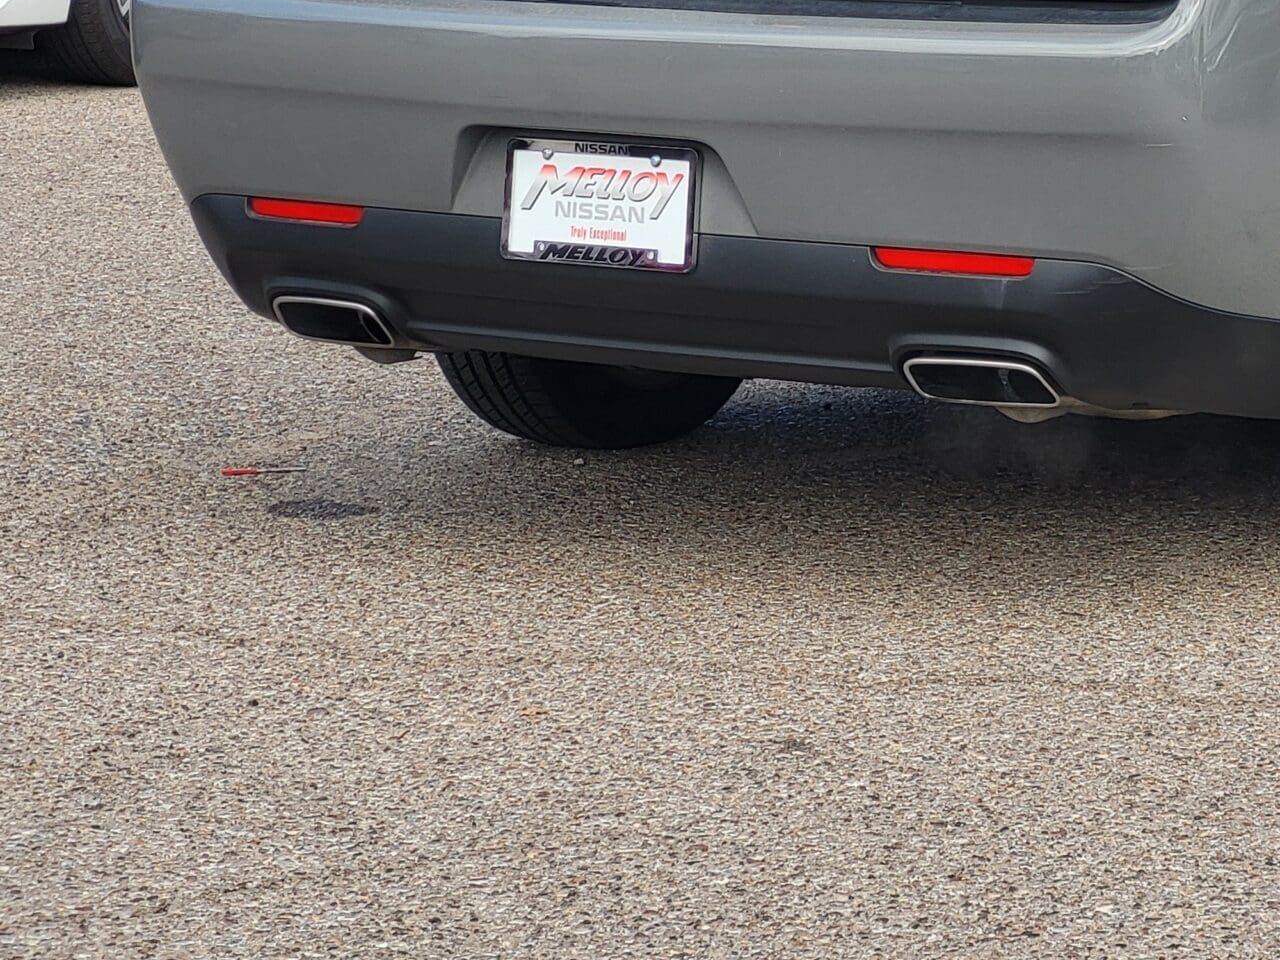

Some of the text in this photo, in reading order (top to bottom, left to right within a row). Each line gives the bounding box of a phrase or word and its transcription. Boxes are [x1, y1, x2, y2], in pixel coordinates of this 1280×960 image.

[574, 143, 629, 155] NISSAN
[520, 164, 684, 220] MELLOY
[555, 200, 645, 224] NISSAN
[571, 225, 627, 242] Truly Exceptional
[539, 243, 645, 266] MELLOY
